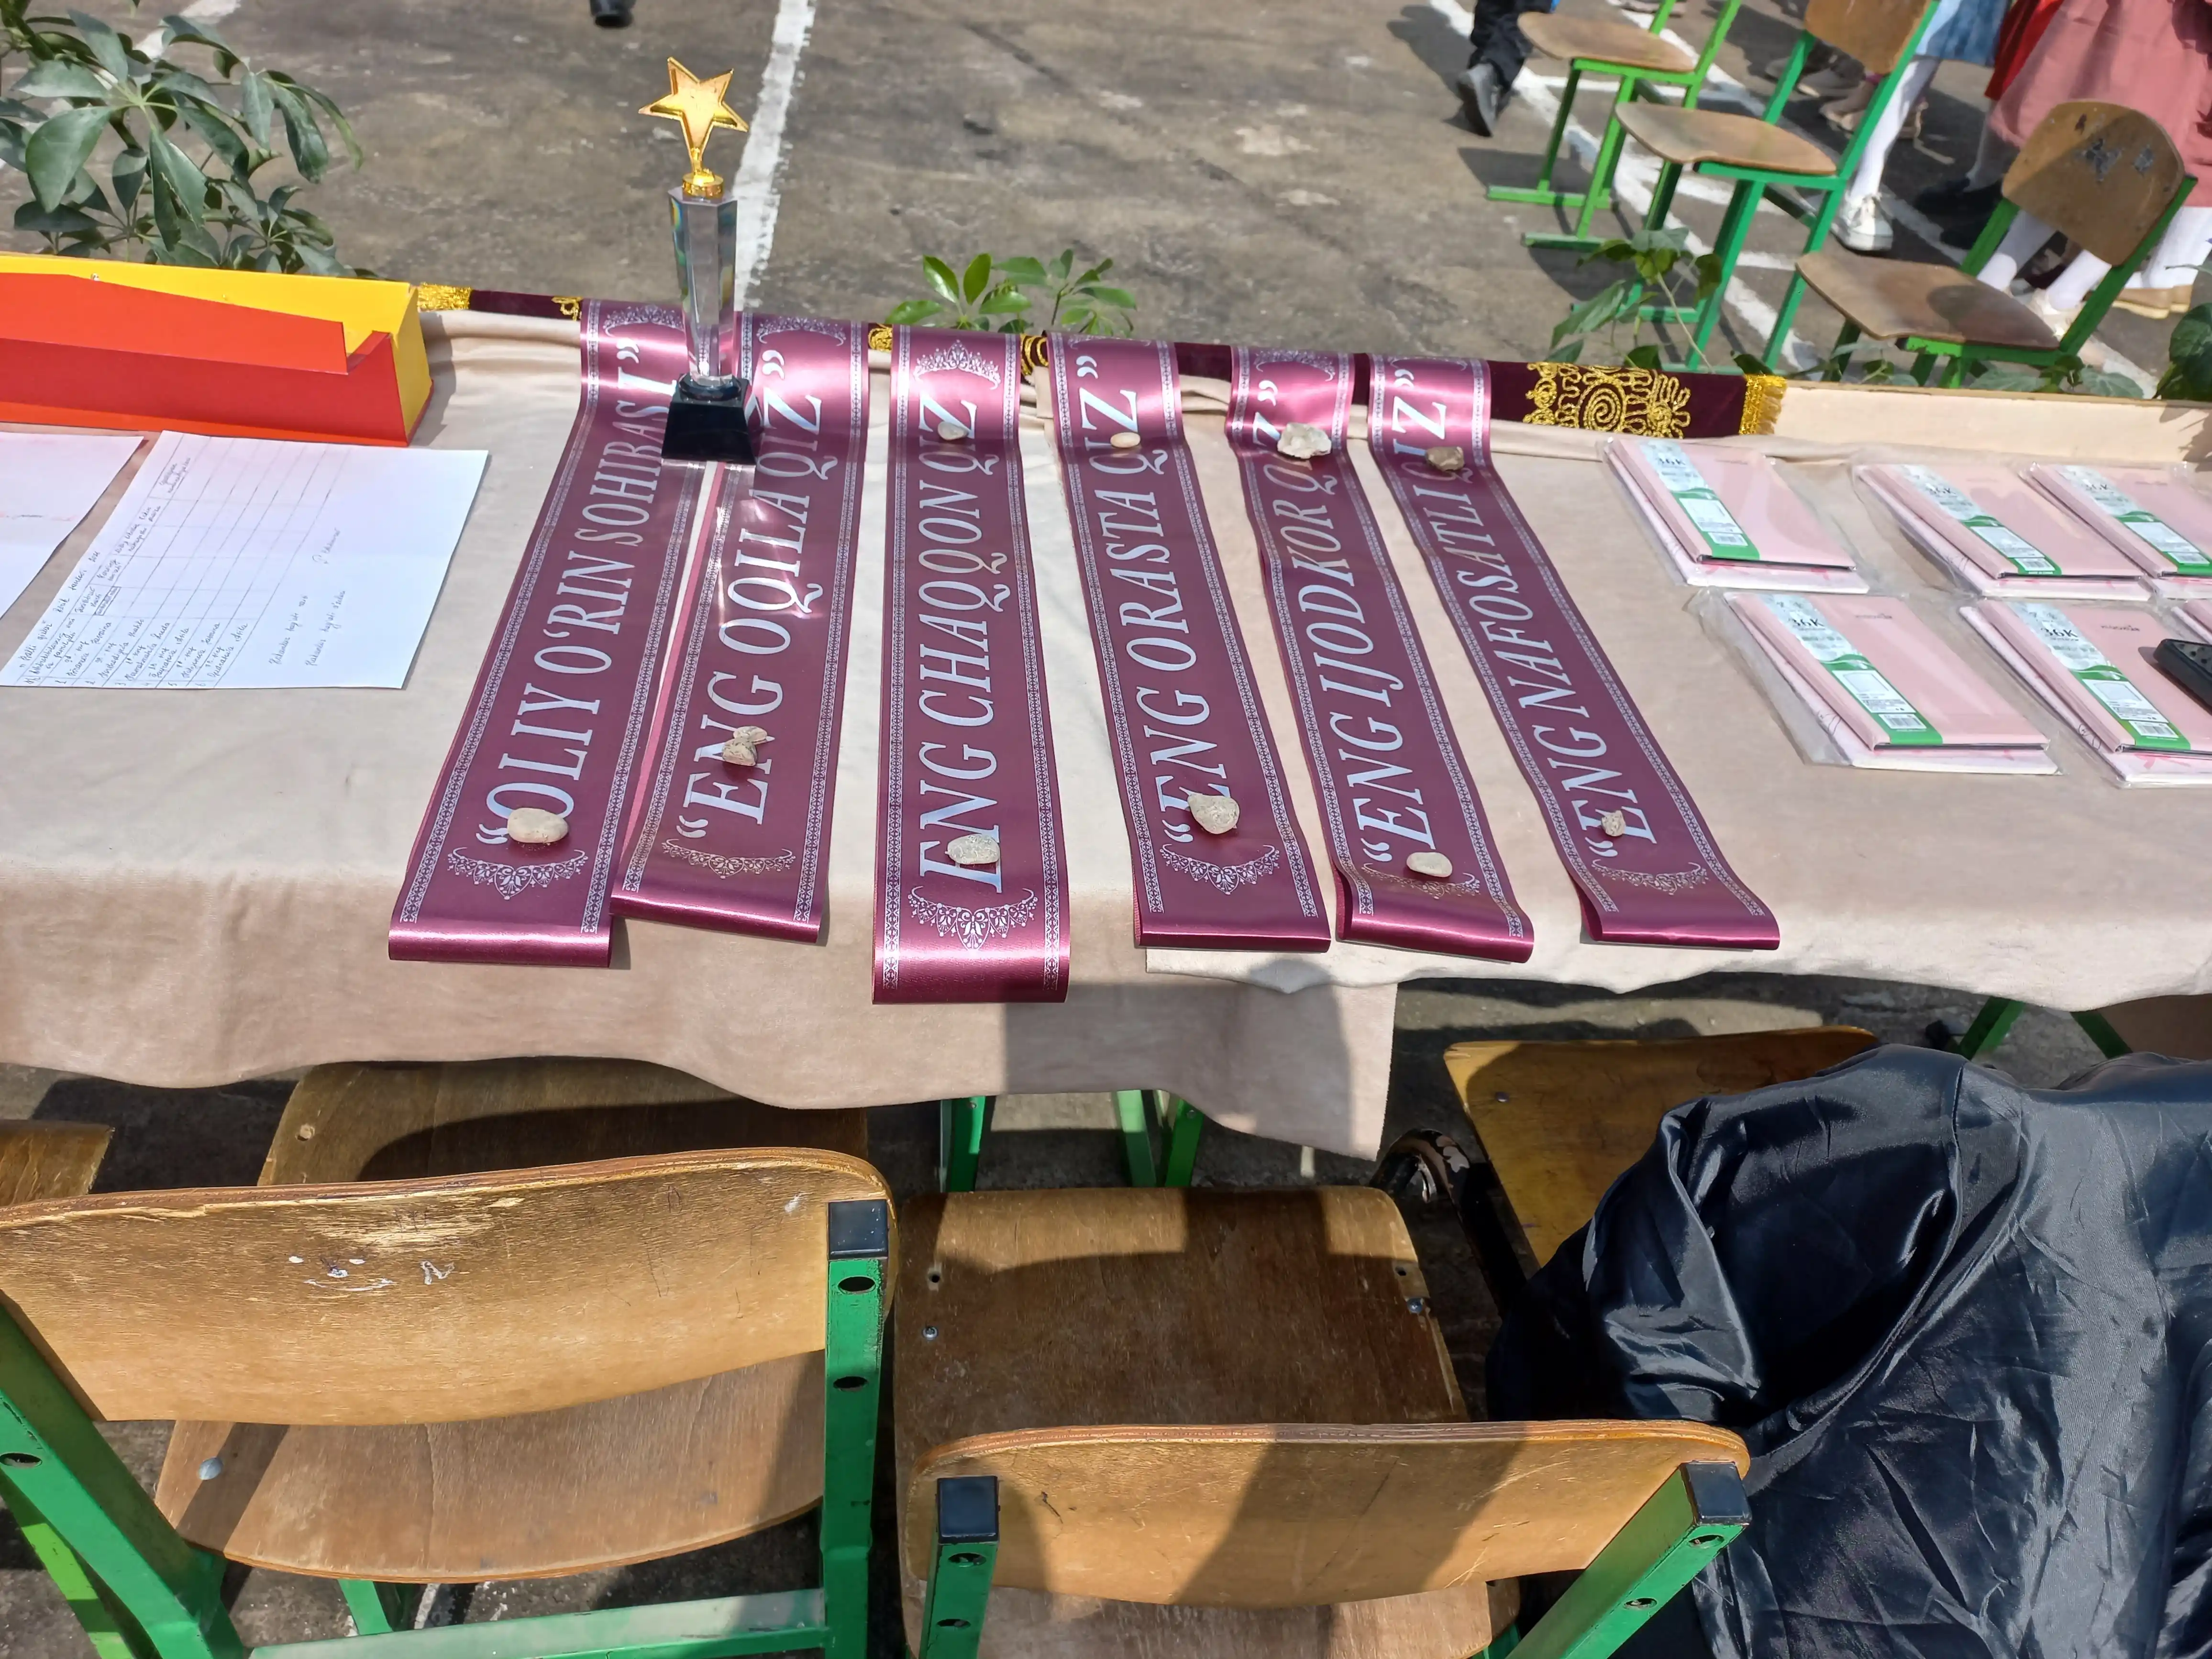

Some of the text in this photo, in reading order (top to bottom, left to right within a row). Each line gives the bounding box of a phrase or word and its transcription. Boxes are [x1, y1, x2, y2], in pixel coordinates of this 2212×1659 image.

[676, 350, 838, 838] “ENG OQILA QIZ”
[918, 391, 1011, 894] ENG CHAQQON QIZ
[1095, 490, 1196, 671] ORASTA
[1273, 500, 1404, 707] IJODKOR
[1413, 485, 1590, 718] NAFOSATLI
[2040, 628, 2079, 638] 36K
[475, 683, 600, 845] “OLIY
[1330, 712, 1436, 862] “ENG
[1532, 725, 1657, 857] “ENG
